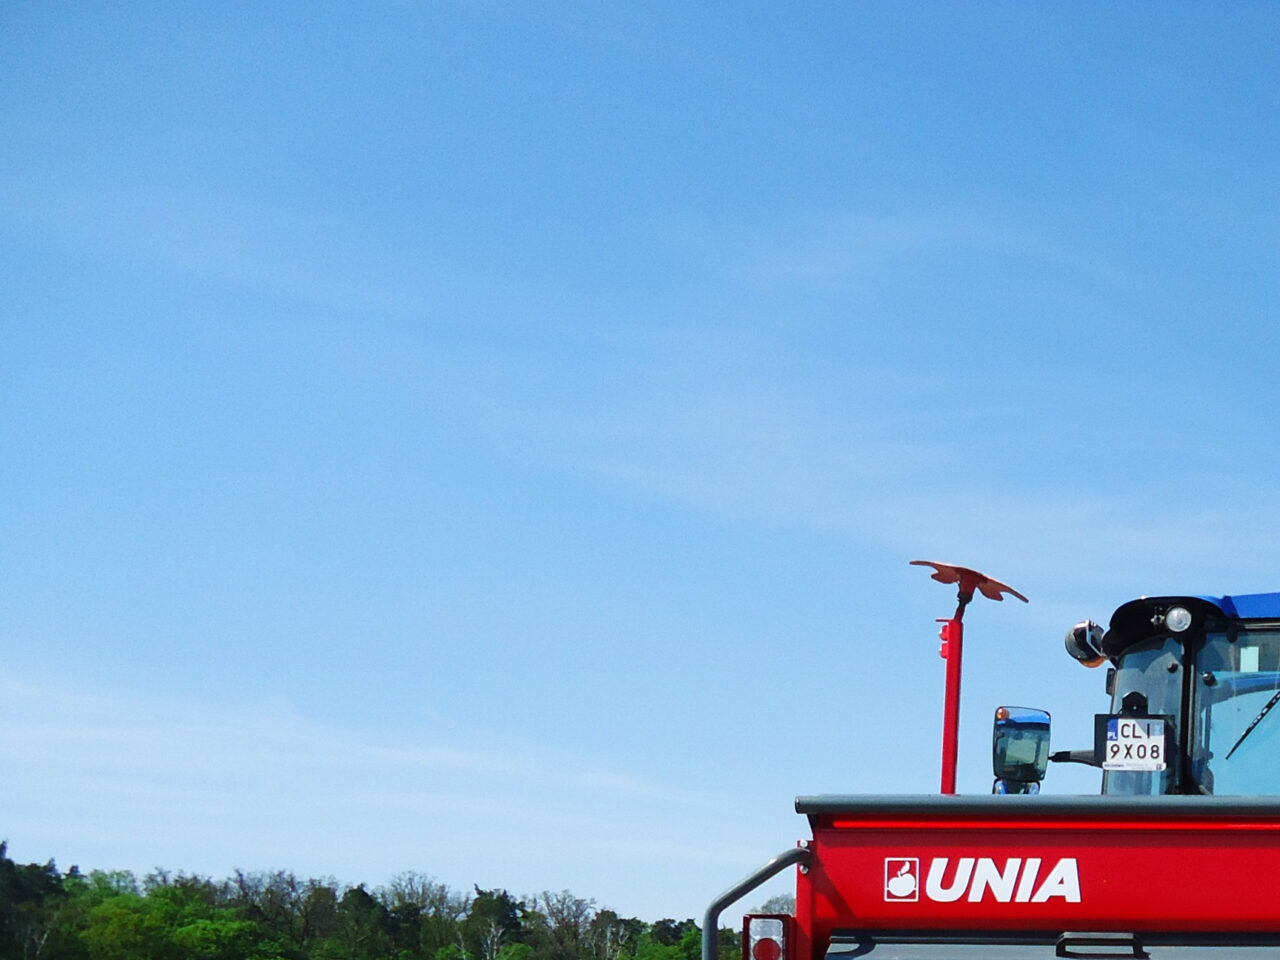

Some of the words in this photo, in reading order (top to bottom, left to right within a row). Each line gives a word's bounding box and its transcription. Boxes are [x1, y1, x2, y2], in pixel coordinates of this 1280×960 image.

[1107, 731, 1118, 740] PL
[1120, 723, 1151, 739] CLI
[1110, 743, 1160, 760] 9X08
[925, 857, 1082, 903] UNIA
